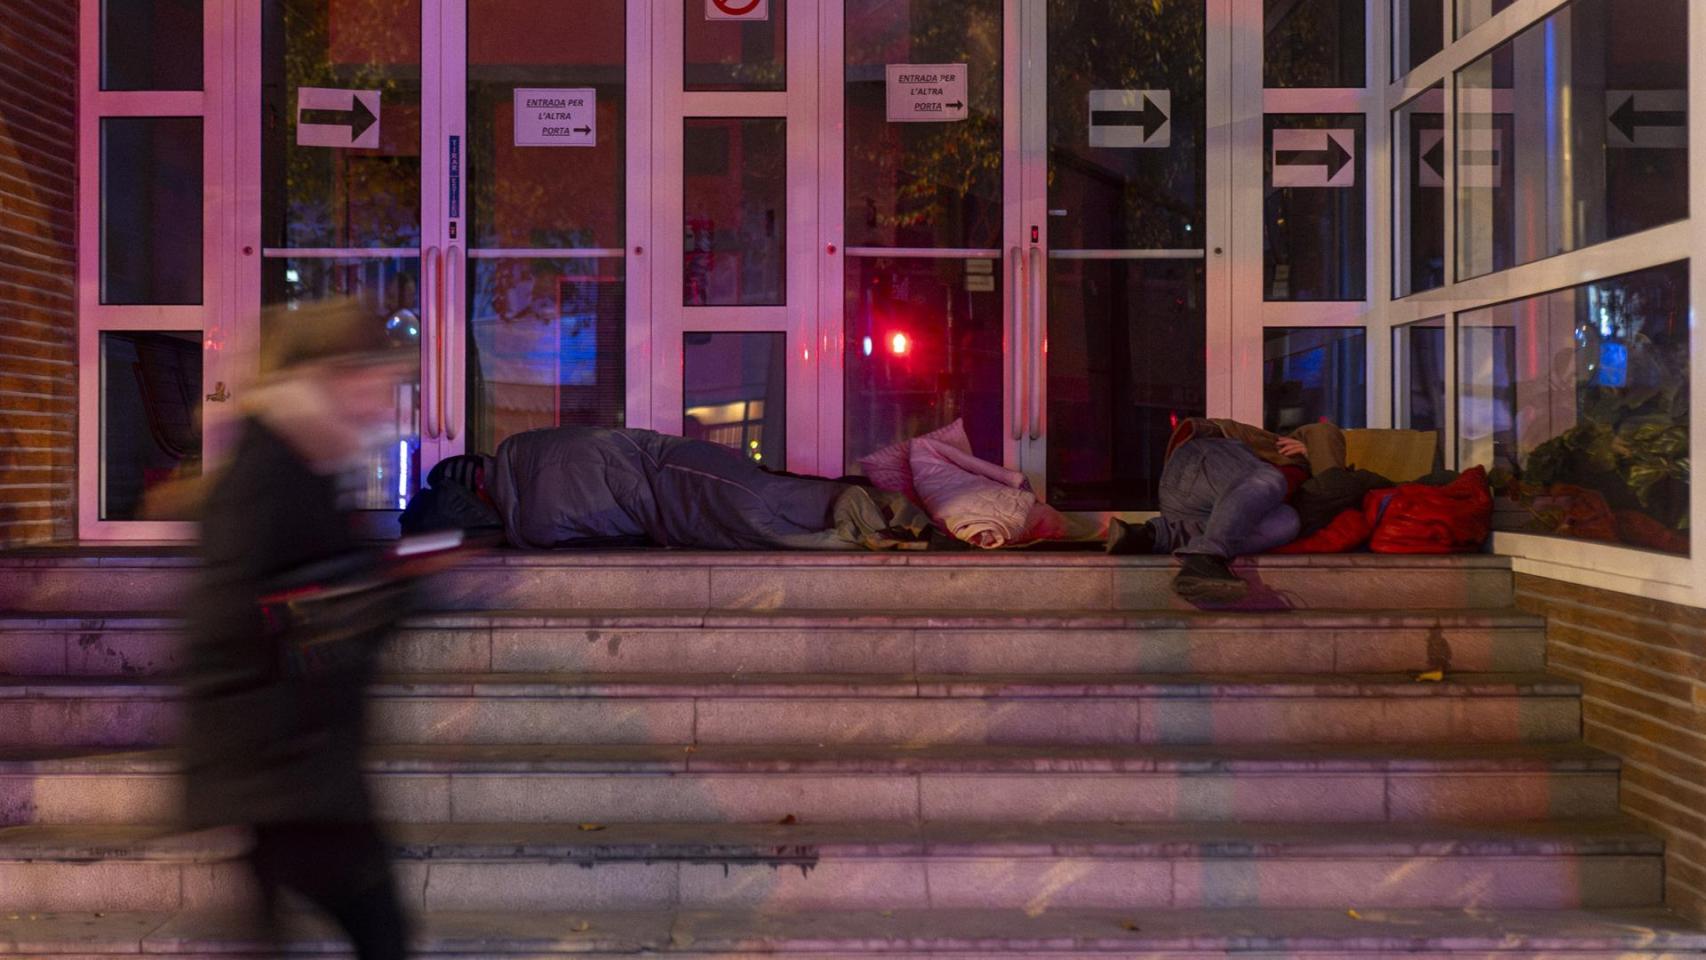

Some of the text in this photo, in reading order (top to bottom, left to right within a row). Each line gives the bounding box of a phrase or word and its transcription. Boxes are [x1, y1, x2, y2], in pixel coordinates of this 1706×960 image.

[898, 74, 956, 83] ENTRADA PER
[910, 88, 944, 96] L'ALTRA
[526, 99, 584, 108] ENTRADA PER
[914, 102, 943, 111] PORTA
[538, 112, 571, 120] L'ALTRA
[541, 127, 570, 136] PORTA
